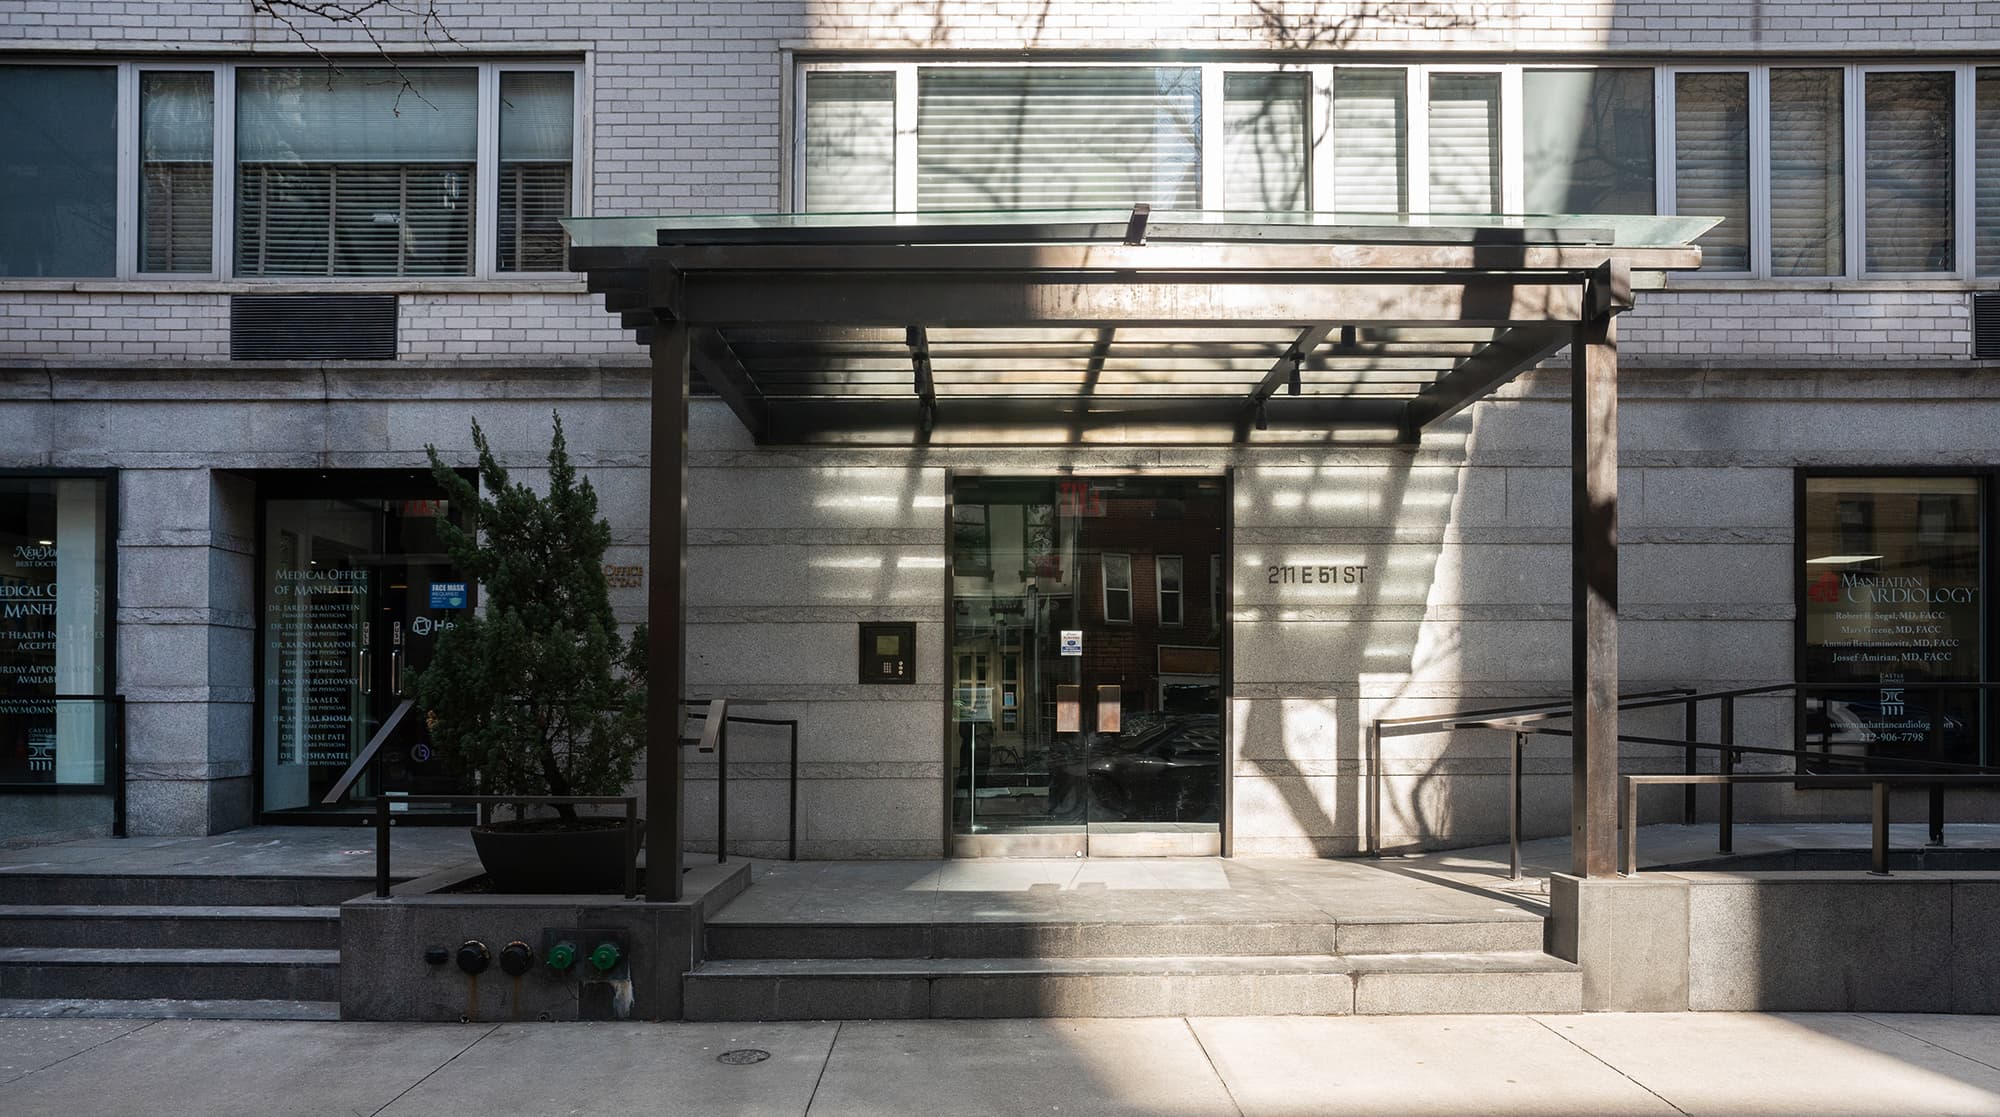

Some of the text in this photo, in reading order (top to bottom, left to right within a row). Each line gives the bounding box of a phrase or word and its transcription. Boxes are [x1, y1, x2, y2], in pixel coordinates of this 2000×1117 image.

[275, 568, 368, 580] MEDICAL OFFICE
[1269, 565, 1369, 584] 211 E 51 ST
[1841, 573, 1922, 589] MANHATTAN
[0, 585, 44, 597] EDICAL
[274, 585, 368, 597] OF MANHATTAN
[1847, 587, 1974, 604] CARDIOLOGY
[1919, 612, 1946, 621] FACC
[1895, 625, 1915, 634] MD,
[1916, 625, 1942, 634] FACC
[8, 631, 45, 640] HEALTH
[18, 642, 60, 650] ACCEPTE
[1913, 639, 1932, 648] MD,
[1933, 639, 1960, 648] FACC
[1862, 653, 1899, 663] Amirian,
[1924, 653, 1952, 662] FACC
[1859, 732, 1924, 742] 212-906-7798
